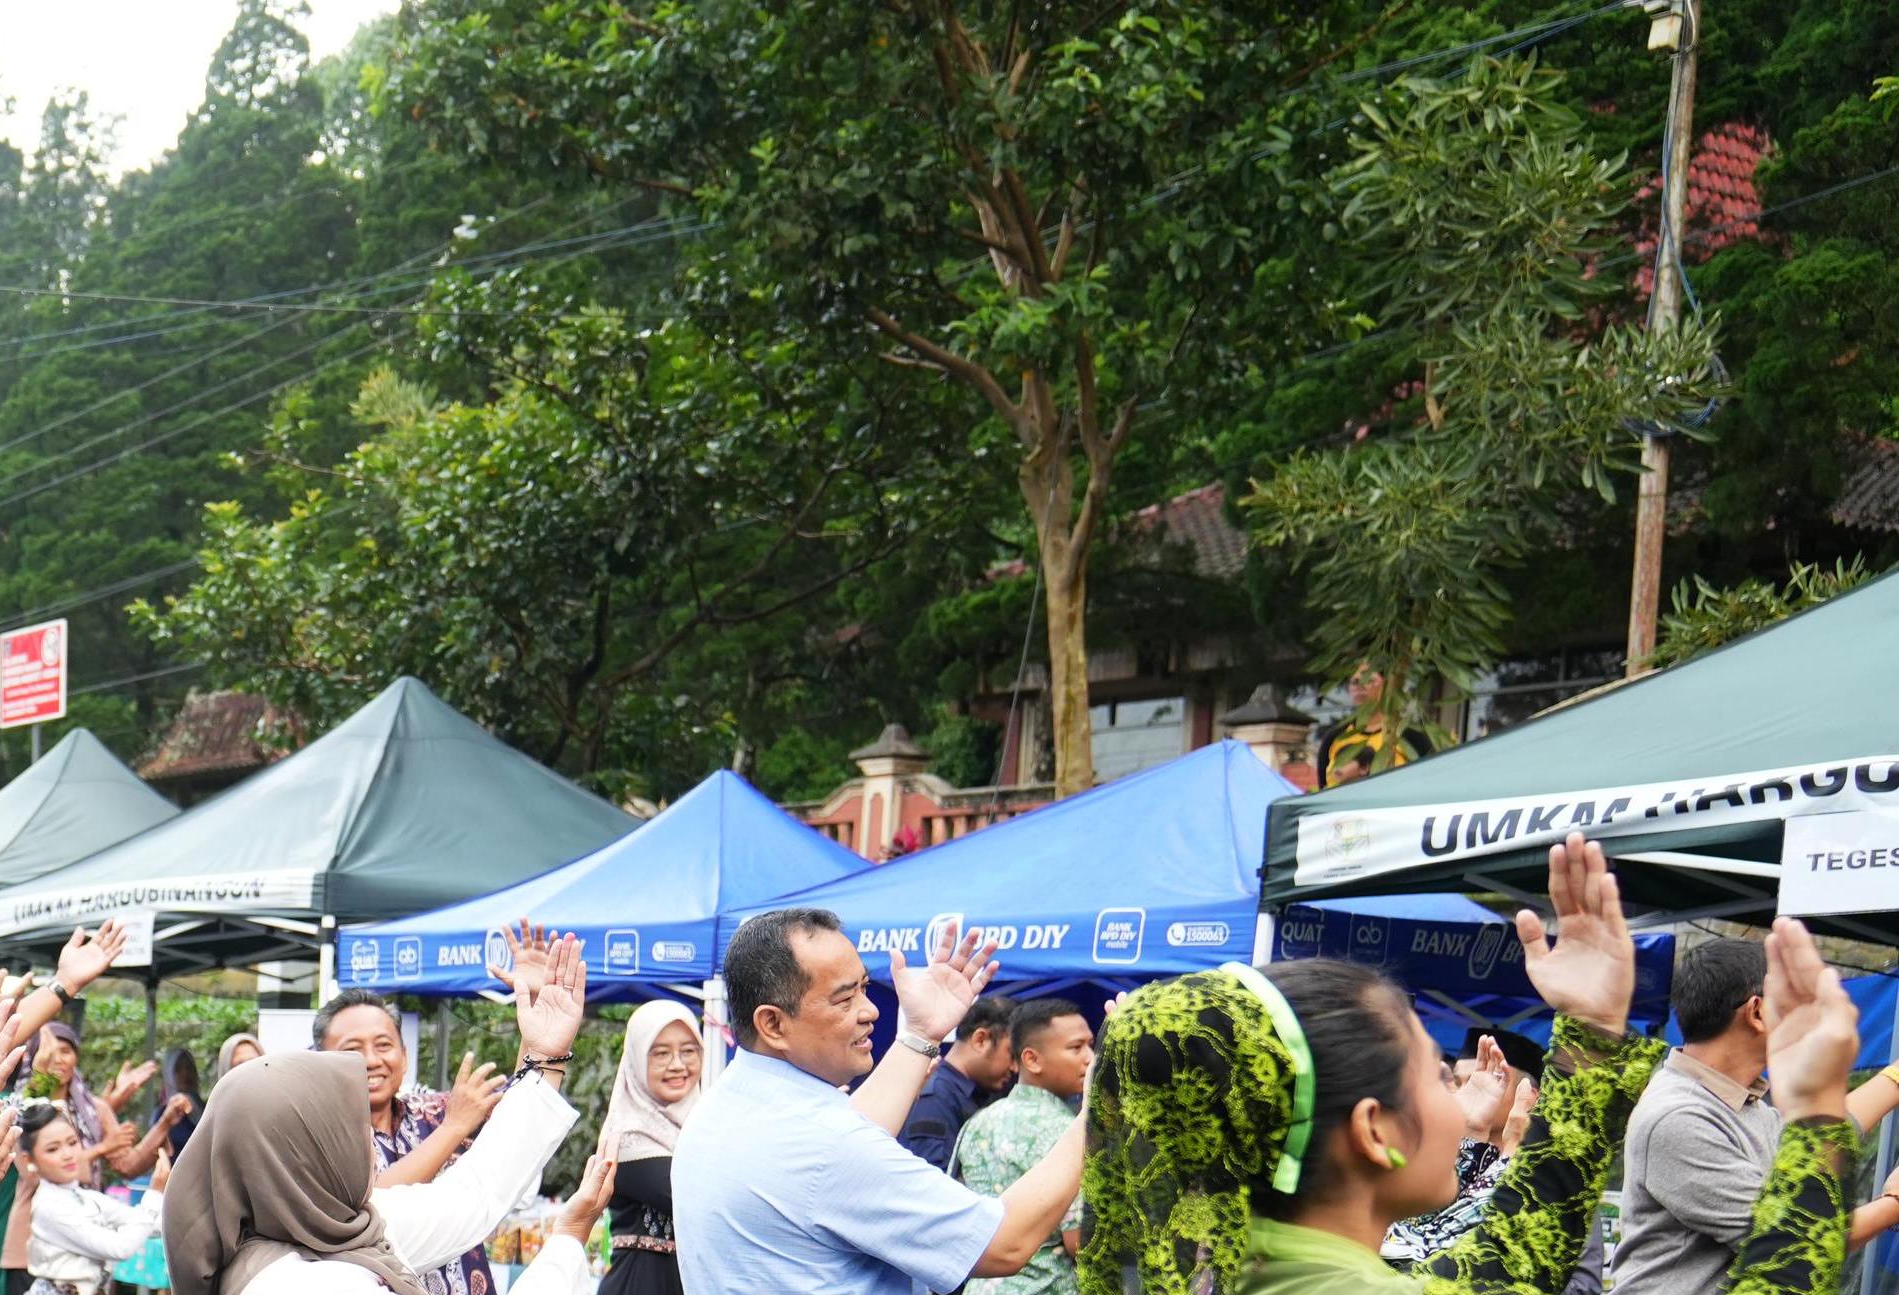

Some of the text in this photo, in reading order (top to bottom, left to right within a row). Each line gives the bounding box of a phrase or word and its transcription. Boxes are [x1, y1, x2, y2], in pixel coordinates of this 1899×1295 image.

[1421, 797, 1633, 858] UMKM
[857, 928, 922, 952] BANK
[1021, 924, 1070, 949] DIY
[1106, 922, 1133, 932] BANK
[1281, 921, 1325, 944] QUAT
[437, 944, 483, 967] BANK
[1410, 928, 1472, 958] BANK
